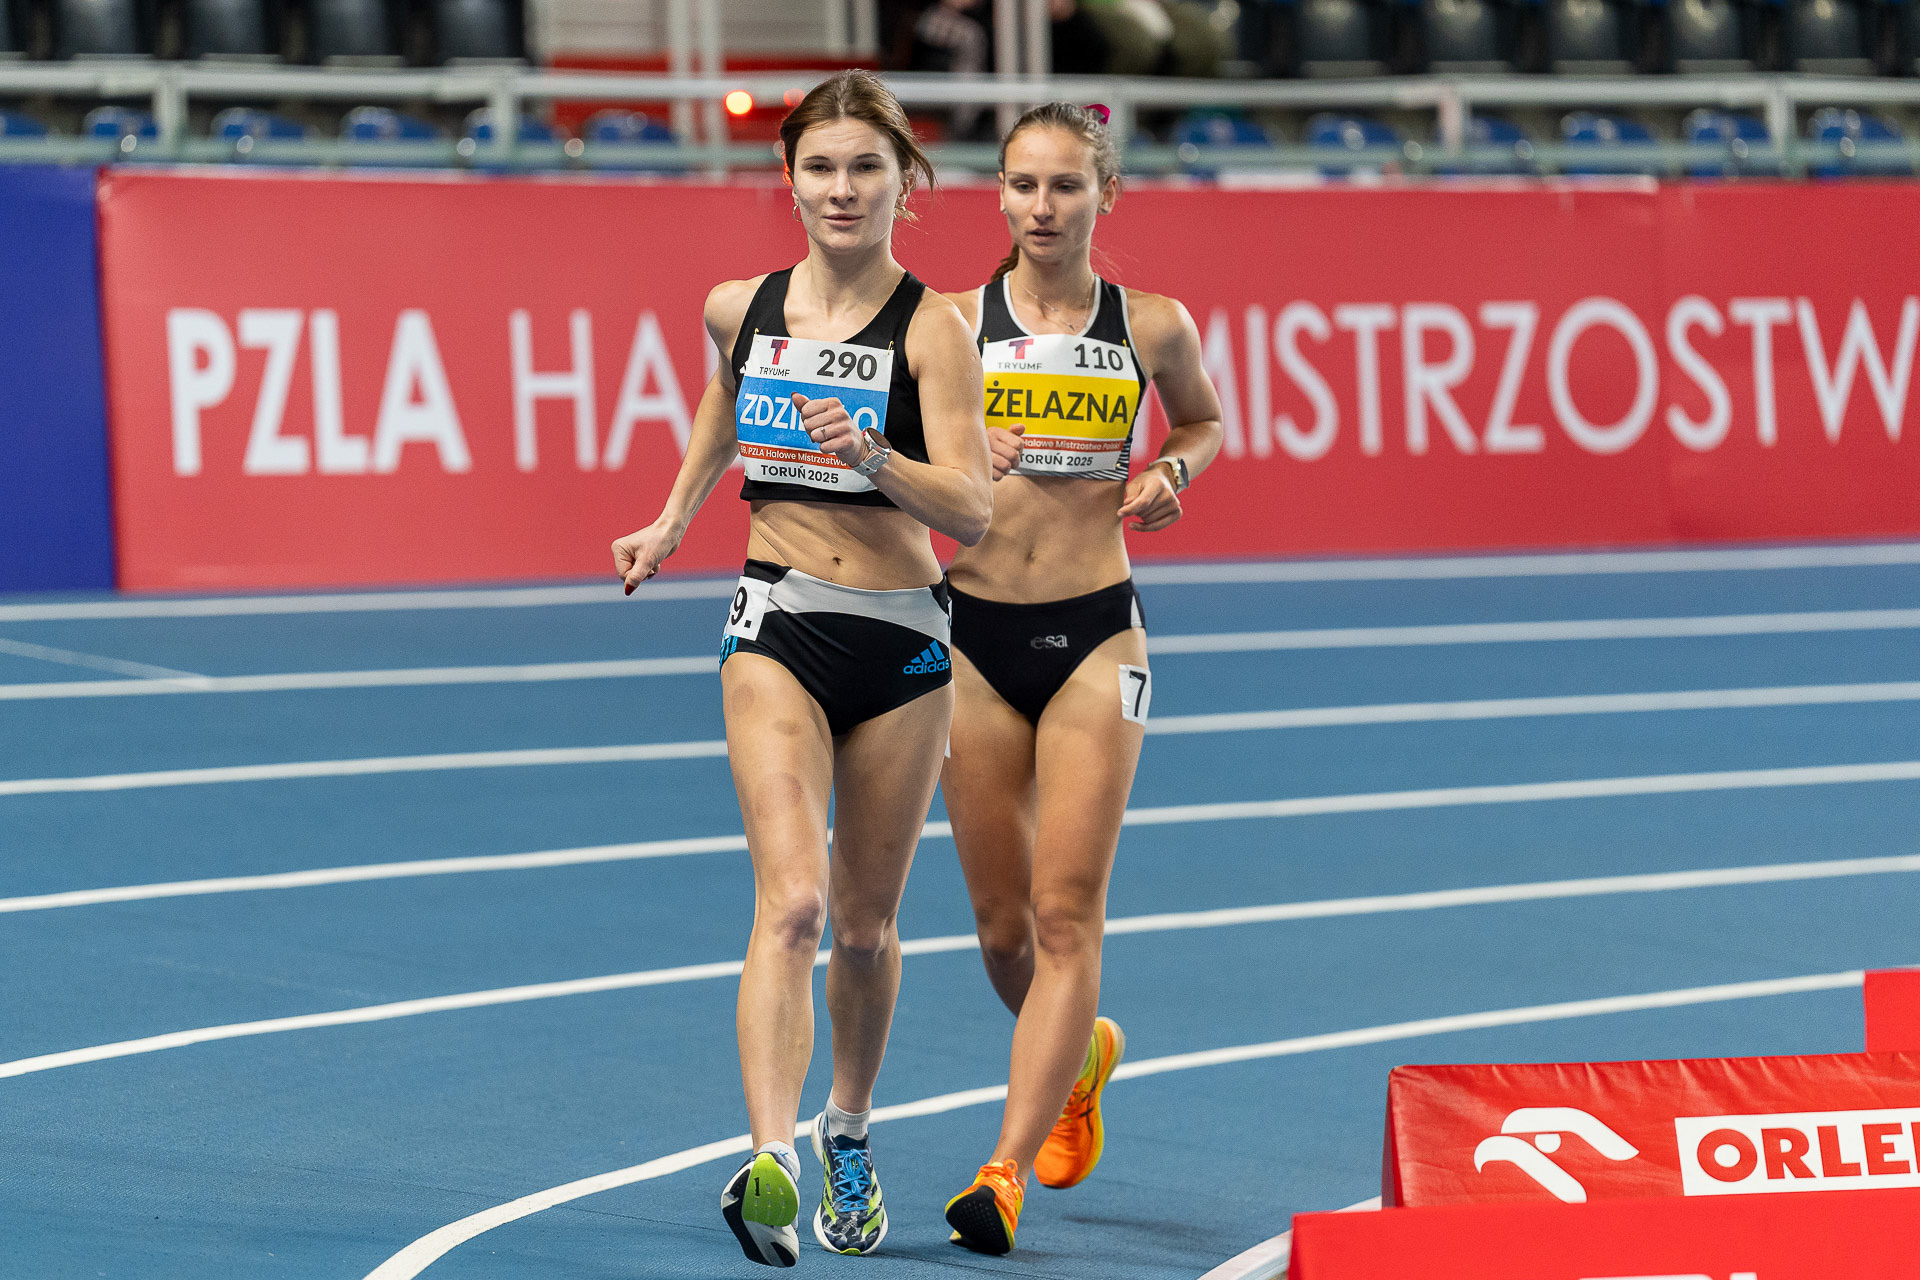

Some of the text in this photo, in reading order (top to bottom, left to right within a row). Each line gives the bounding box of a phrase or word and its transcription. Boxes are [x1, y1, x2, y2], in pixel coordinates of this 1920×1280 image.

[816, 349, 878, 382] 290
[998, 362, 1043, 371] TRYUMF
[1074, 343, 1124, 371] 110
[759, 366, 791, 377] TRYUMF
[167, 308, 473, 476] PZLA
[986, 380, 1128, 424] ŻELAZNA
[748, 447, 765, 457] PZLA
[766, 449, 796, 460] Halowe
[1066, 456, 1093, 466] 2025
[760, 465, 839, 484] TORUŃ 2025
[1030, 634, 1069, 650] esa
[903, 658, 950, 675] adidas
[1129, 670, 1147, 718] 7
[1697, 1121, 1920, 1183] ORLE
